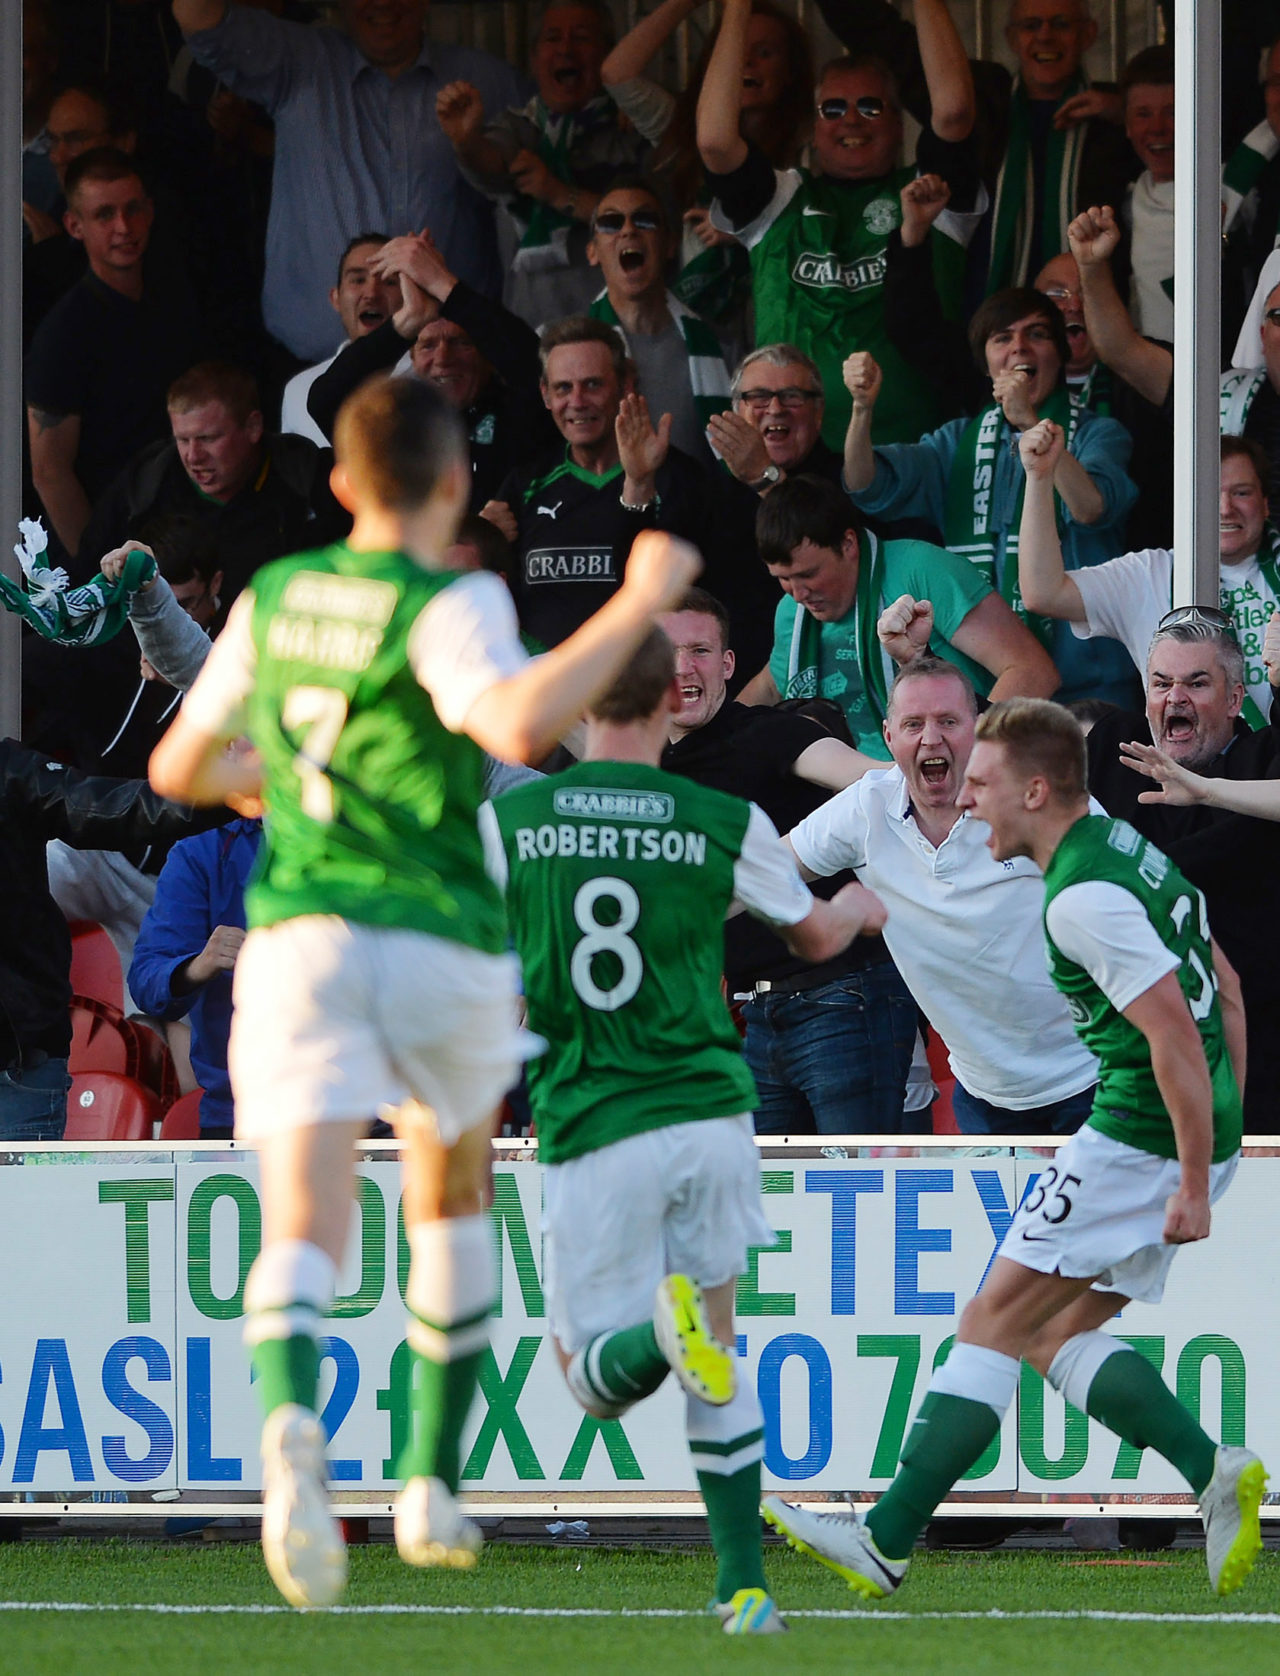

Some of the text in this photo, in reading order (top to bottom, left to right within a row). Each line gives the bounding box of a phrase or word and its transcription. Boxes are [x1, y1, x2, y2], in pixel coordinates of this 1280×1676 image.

[973, 405, 1001, 536] EASTER
[529, 555, 615, 578] CRABBI
[281, 684, 349, 826] 7
[557, 792, 667, 818] CRABBIE'S
[515, 824, 708, 866] ROBERTSON
[570, 875, 644, 1012] 8
[1025, 1166, 1082, 1224] 35
